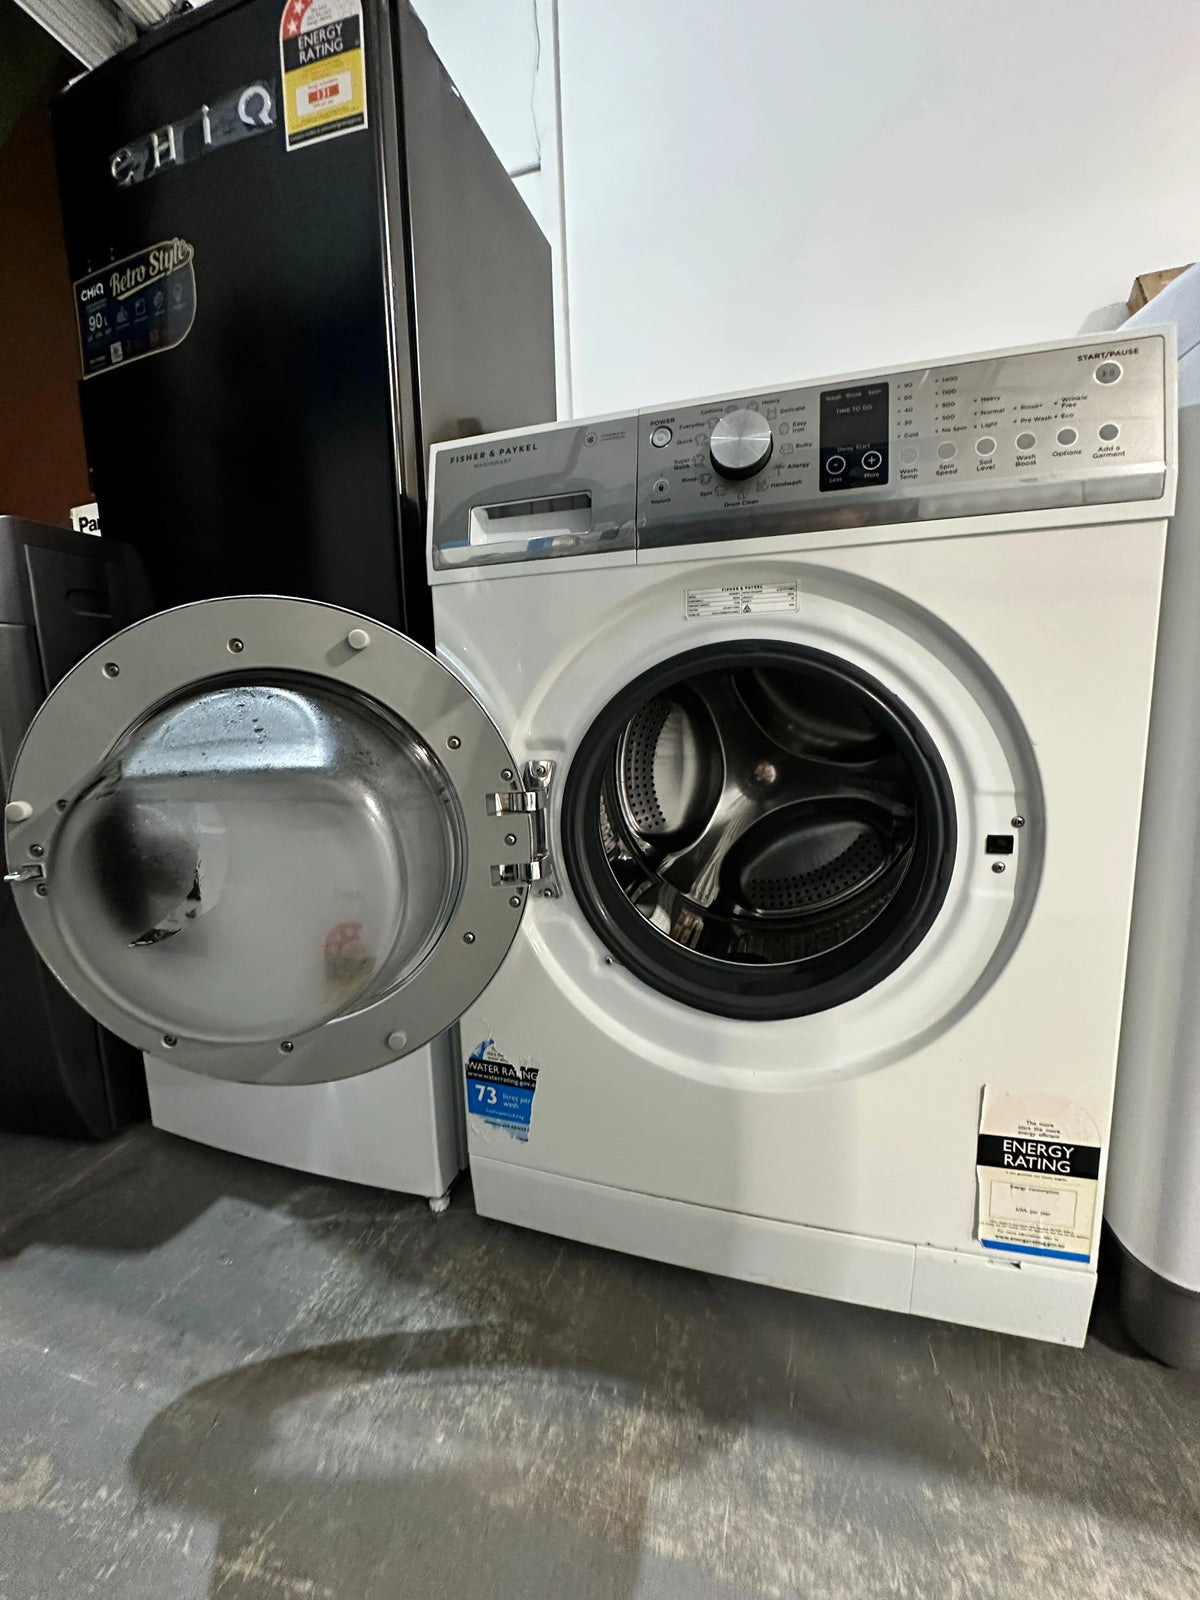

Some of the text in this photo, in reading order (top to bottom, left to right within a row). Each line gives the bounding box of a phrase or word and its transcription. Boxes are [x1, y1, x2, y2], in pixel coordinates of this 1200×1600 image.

[298, 22, 343, 50] ENERGY
[299, 39, 344, 64] RATING
[110, 239, 191, 297] Retro Style
[81, 283, 104, 301] CHiQ
[89, 312, 102, 332] 90
[1077, 348, 1140, 362] START/PAUSE
[981, 408, 1005, 416] Normal
[650, 417, 675, 426] POWER
[981, 421, 998, 429] Light
[450, 443, 538, 464] FISHER & PAYKEL
[1052, 449, 1082, 458] Options
[1097, 445, 1114, 453] Add
[1092, 450, 1126, 459] Garment
[787, 462, 810, 470] Allergy
[939, 463, 955, 471] Spin
[976, 464, 996, 472] Level
[1015, 460, 1037, 468] Boost
[900, 473, 918, 481] Temp
[935, 469, 958, 477] Speed
[724, 500, 741, 508] Drum
[79, 517, 100, 532] Pa
[469, 1061, 538, 1080] WATER RAING
[475, 1084, 498, 1104] 73
[502, 1092, 531, 1104] litres per
[504, 1101, 519, 1109] wash
[1026, 1119, 1038, 1127] The
[1018, 1130, 1036, 1138] energy
[1002, 1138, 1075, 1159] ENERGY
[1004, 1154, 1071, 1174] RATING
